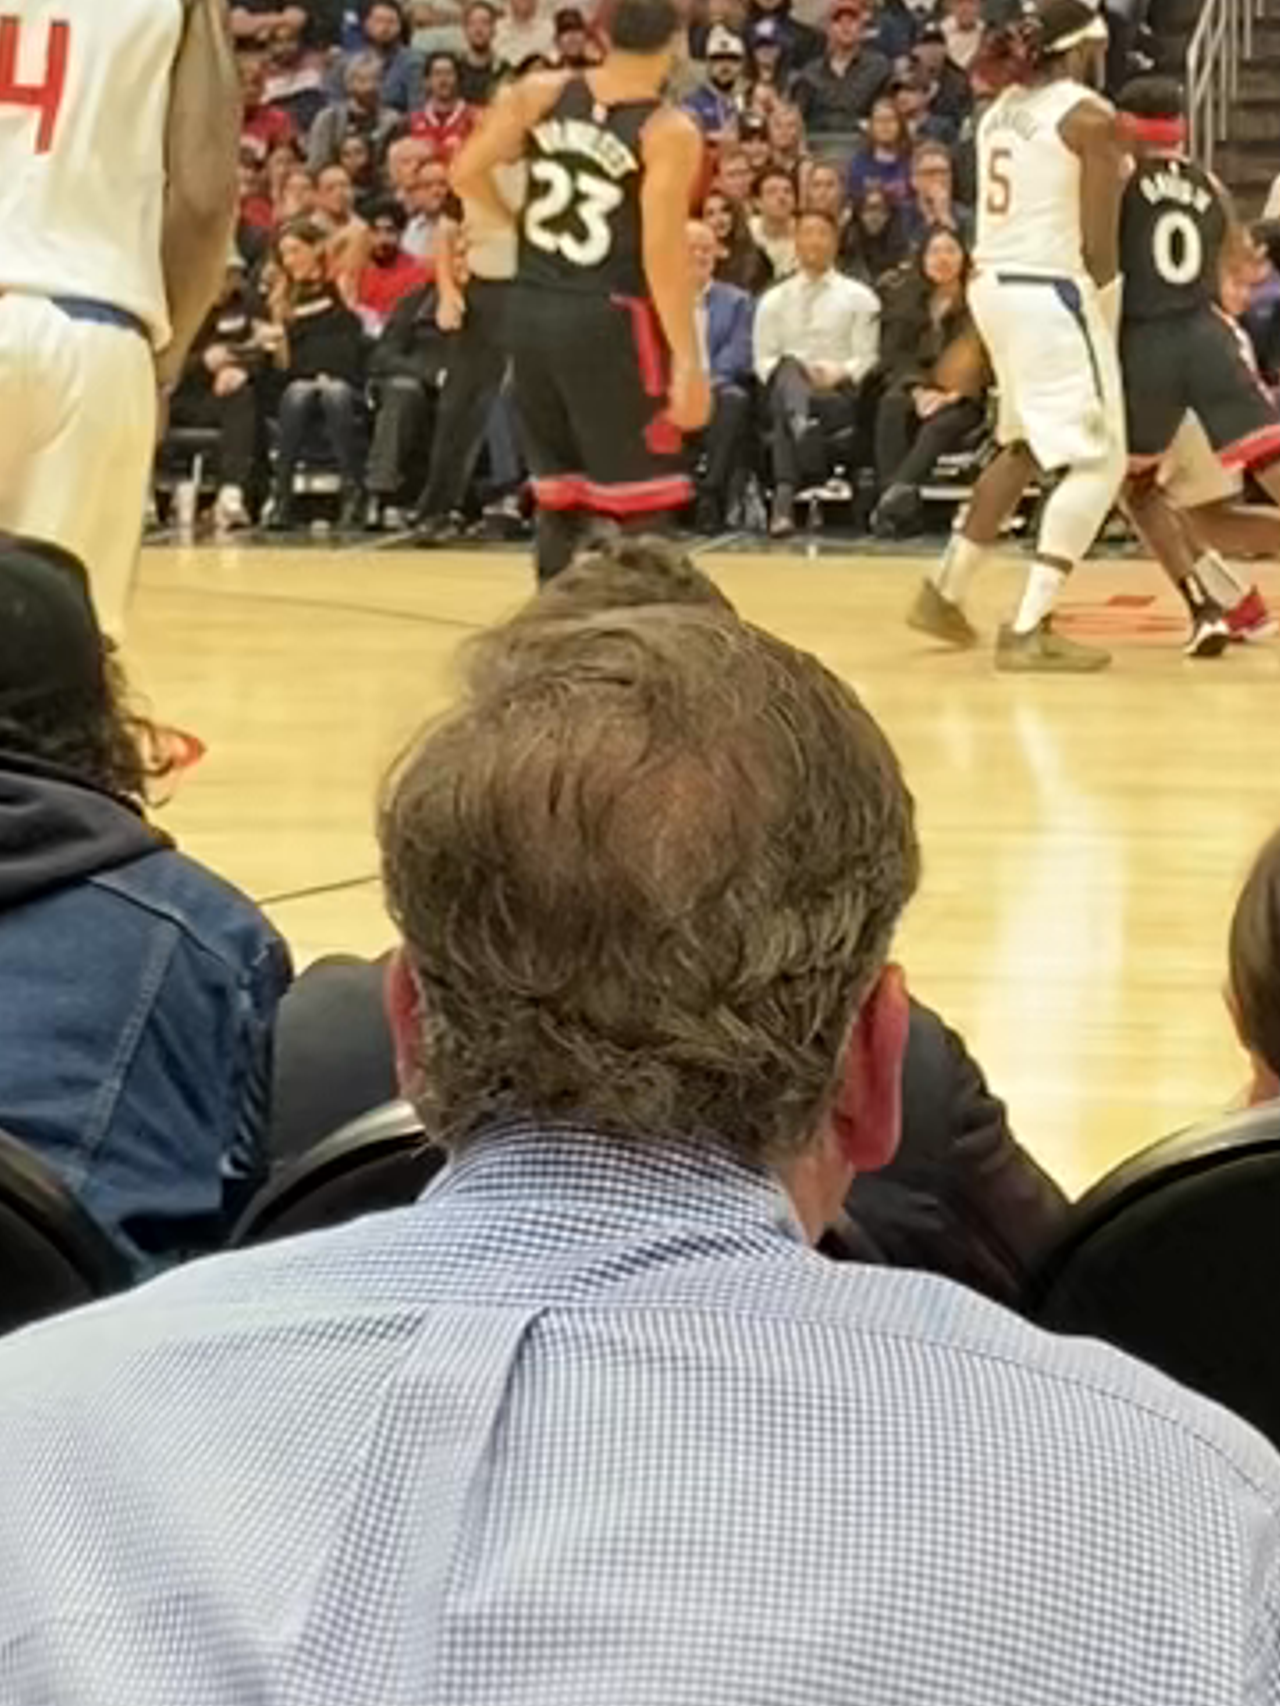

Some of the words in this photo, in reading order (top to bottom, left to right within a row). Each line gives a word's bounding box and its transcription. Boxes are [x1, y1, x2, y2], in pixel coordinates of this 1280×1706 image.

[525, 159, 624, 266] 23
[986, 148, 1013, 215] 5
[1153, 211, 1202, 285] 0
